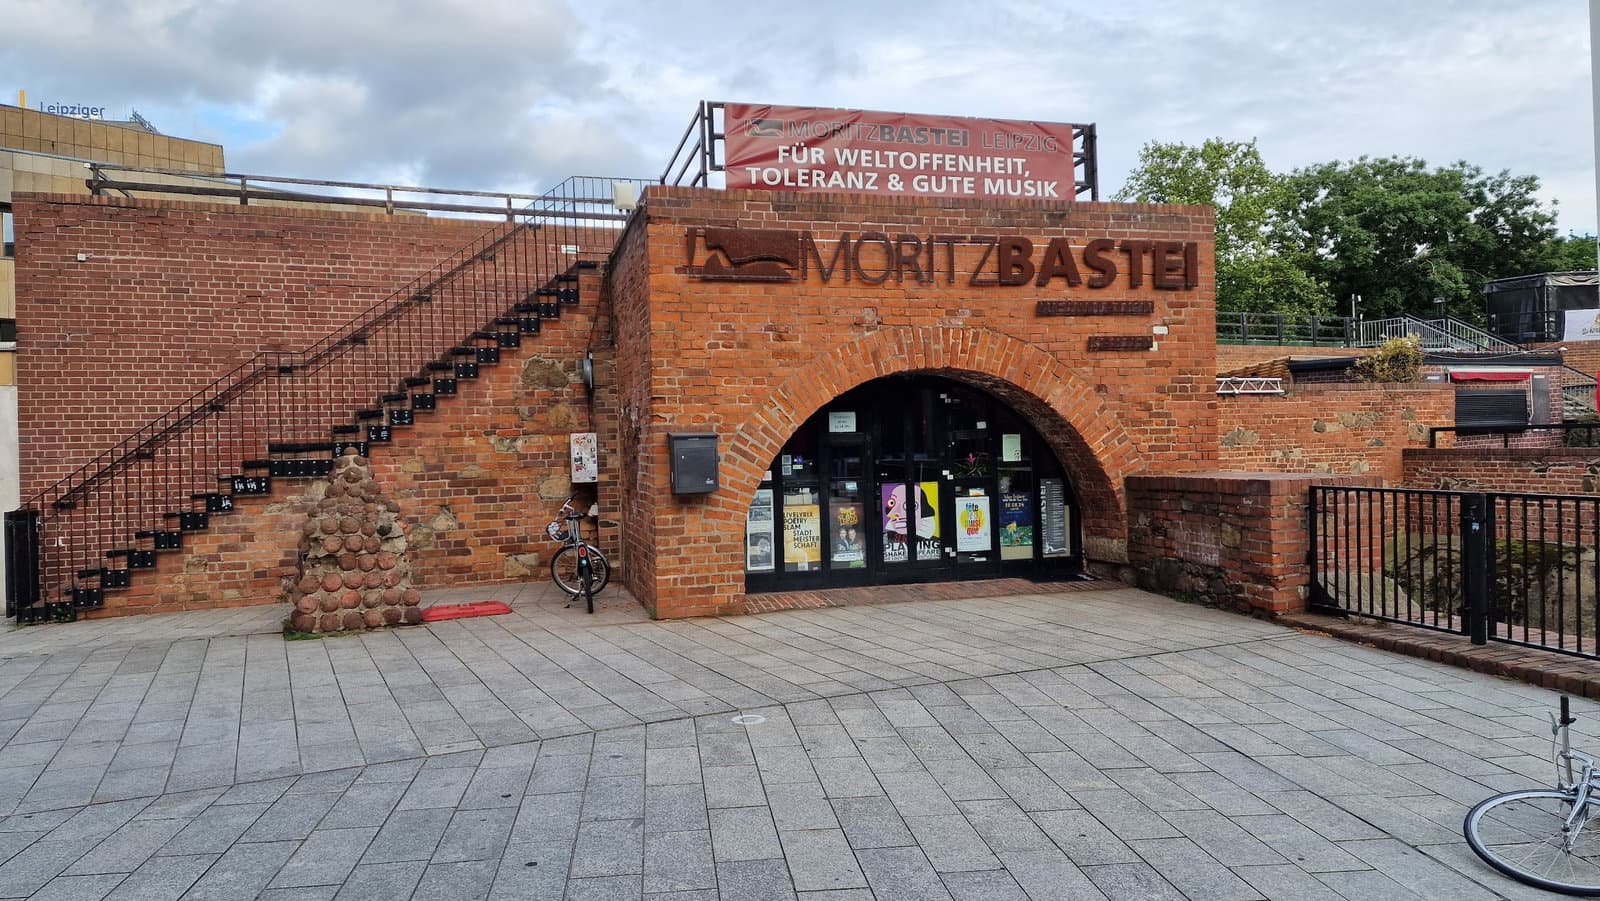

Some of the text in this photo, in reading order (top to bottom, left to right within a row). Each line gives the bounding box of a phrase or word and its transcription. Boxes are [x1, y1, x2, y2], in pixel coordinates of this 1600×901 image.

[789, 120, 1059, 152] MORITZBASTEI LEIPZIG
[777, 142, 1031, 178] FÜR WELTOFFENHEIT,
[745, 167, 1060, 199] TOLERANZ & GUTE MUSIK
[801, 232, 1198, 291] MORITZBASTEI
